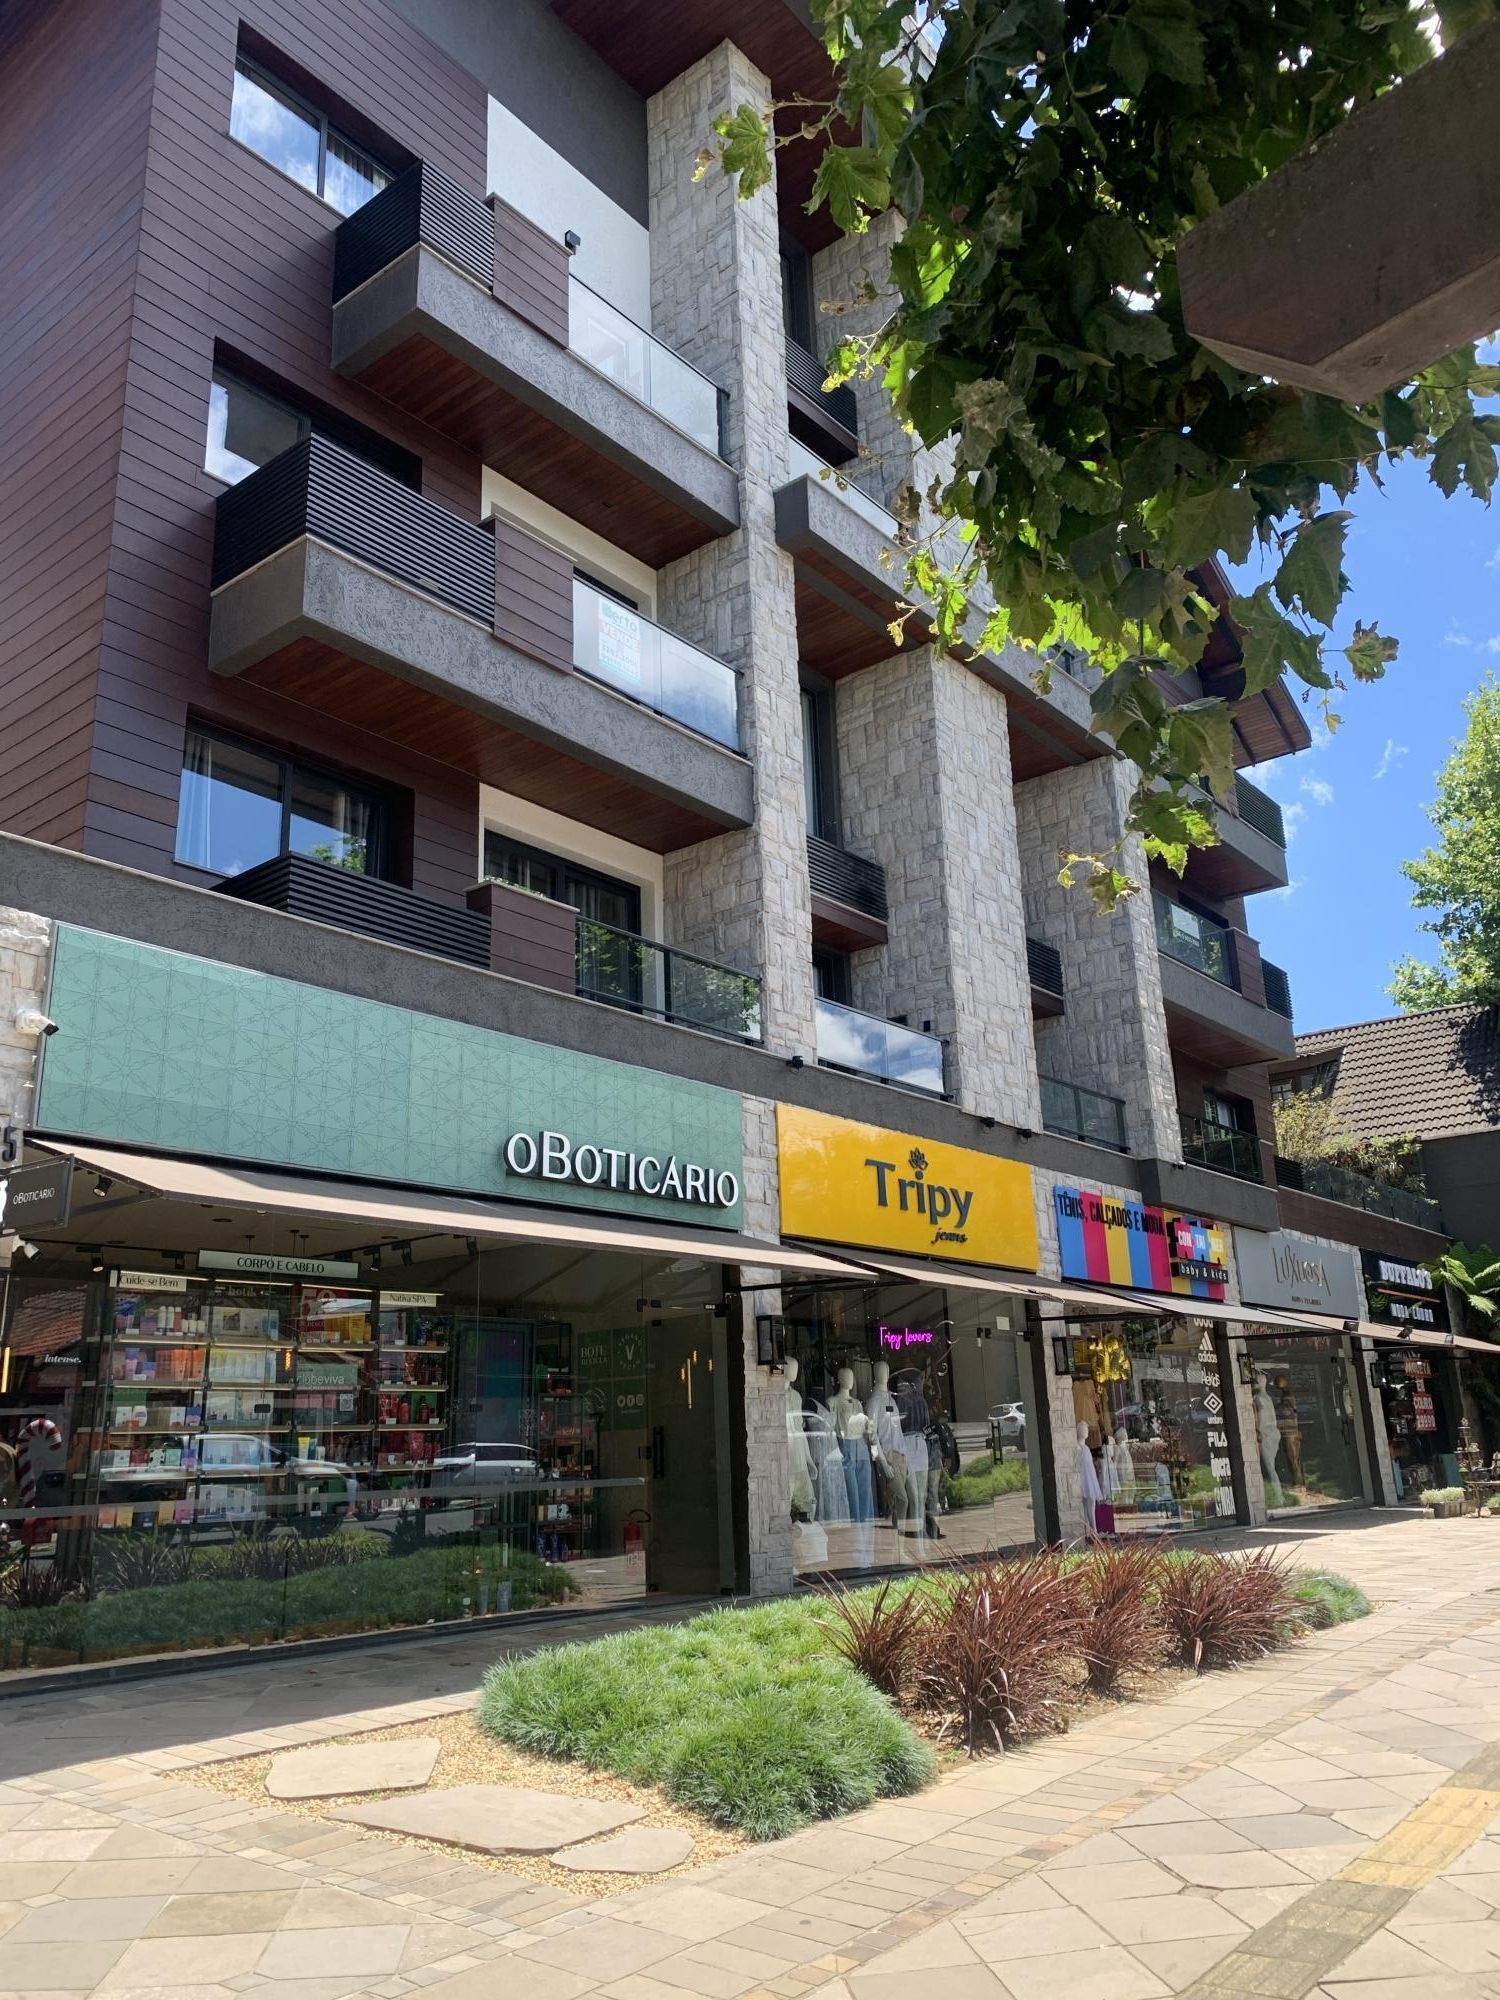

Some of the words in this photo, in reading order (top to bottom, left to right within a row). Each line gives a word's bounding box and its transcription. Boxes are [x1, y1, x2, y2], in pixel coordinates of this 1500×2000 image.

[864, 1158, 974, 1228] Tripy
[1057, 1191, 1087, 1222] TÊNIS,
[1090, 1200, 1133, 1230] CALÇADOS
[1134, 1213, 1141, 1231] E
[1142, 1212, 1165, 1236] MODA
[930, 1227, 968, 1244] jeans
[237, 1256, 275, 1270] CORPO
[277, 1258, 284, 1270] E
[285, 1260, 325, 1274] CABELO
[1180, 1263, 1199, 1280] baby
[1210, 1268, 1227, 1281] kids
[1198, 1350, 1218, 1363] adidas
[1207, 1431, 1228, 1448] FILA
